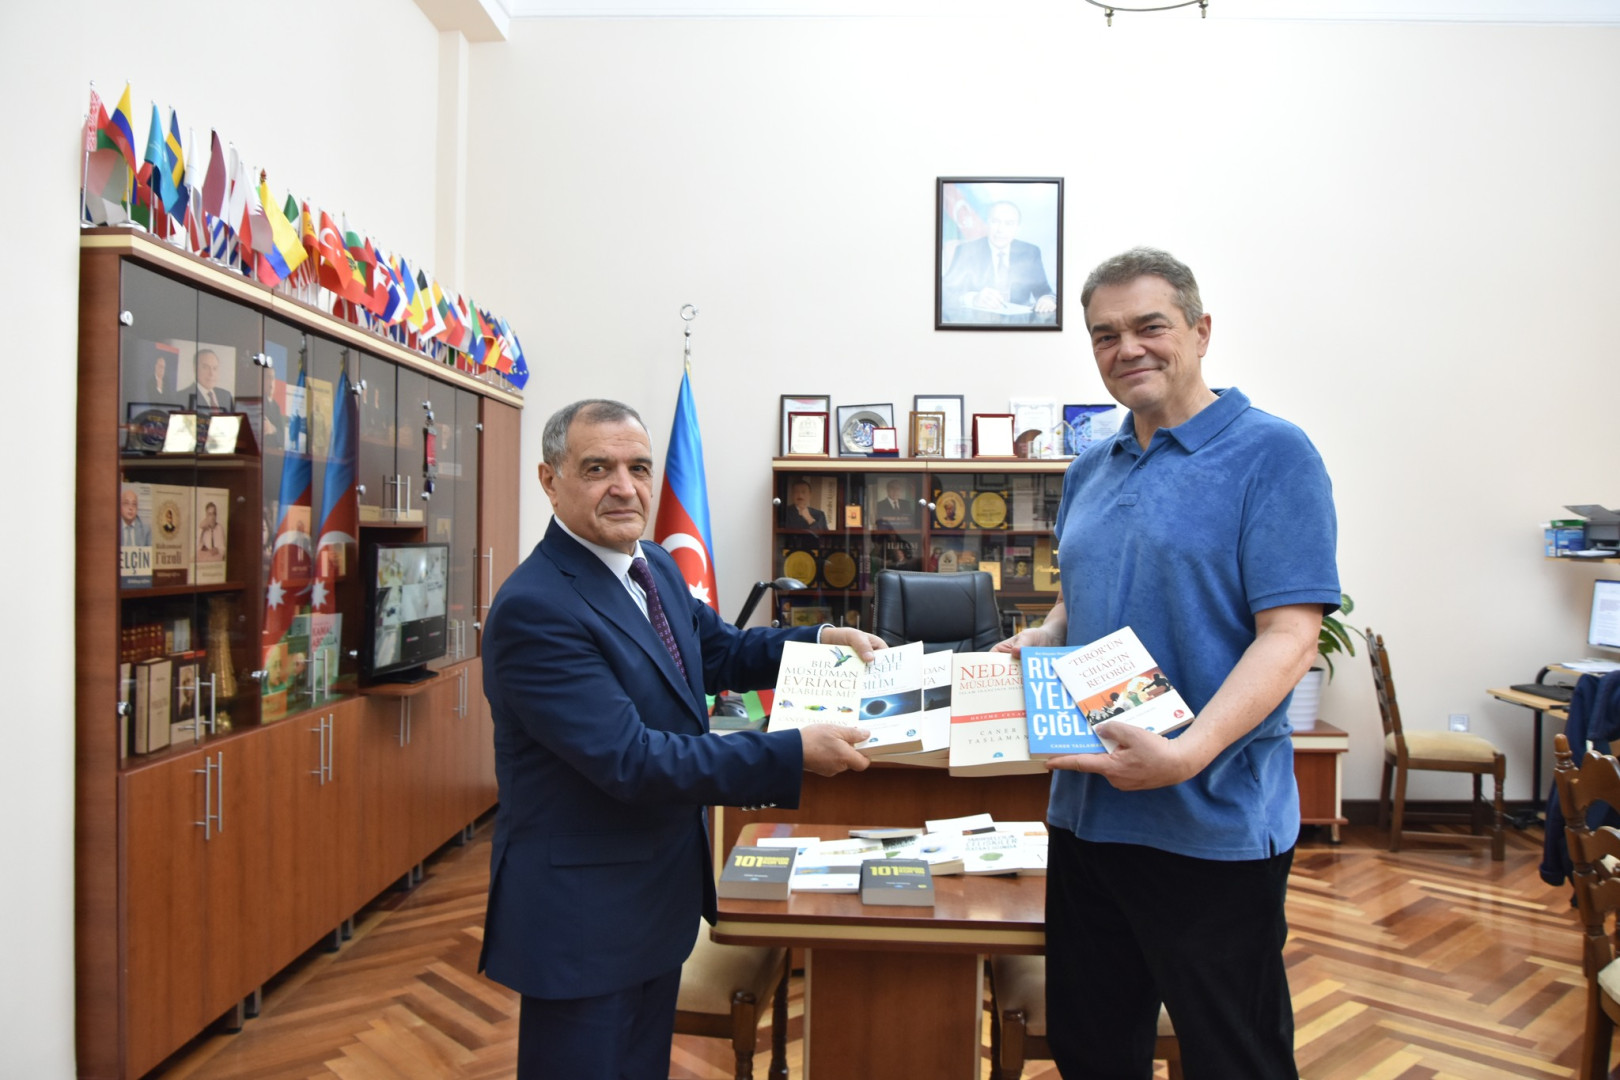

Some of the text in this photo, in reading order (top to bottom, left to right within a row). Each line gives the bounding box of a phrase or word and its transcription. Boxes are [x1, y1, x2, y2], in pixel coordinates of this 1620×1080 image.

[960, 663, 1020, 680] NEDE
[1027, 657, 1058, 679] RU
[783, 675, 857, 690] EVRİMCİ
[1030, 681, 1077, 710] YED
[979, 727, 1016, 736] CANER
[734, 855, 763, 867] 101
[870, 866, 898, 876] 101
